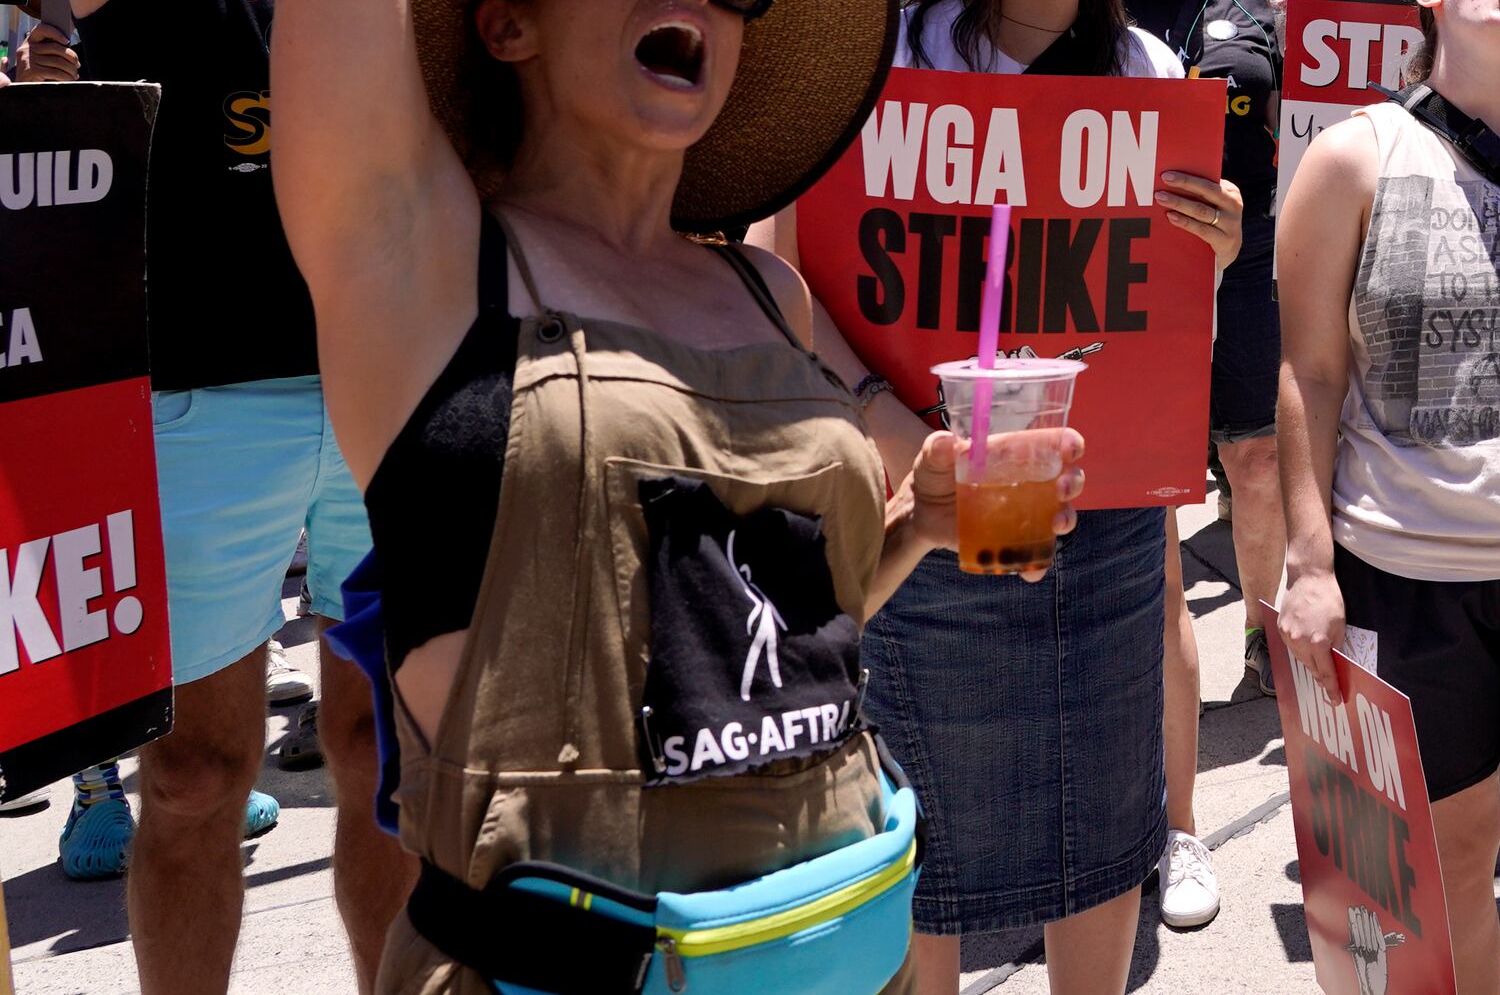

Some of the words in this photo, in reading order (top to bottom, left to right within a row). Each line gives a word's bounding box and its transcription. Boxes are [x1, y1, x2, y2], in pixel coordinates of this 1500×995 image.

[861, 101, 1027, 207] WGA
[1059, 109, 1160, 208] ON
[857, 208, 1151, 335] STRIKE
[1355, 692, 1407, 811] ON
[1304, 747, 1423, 941] STRIKE
